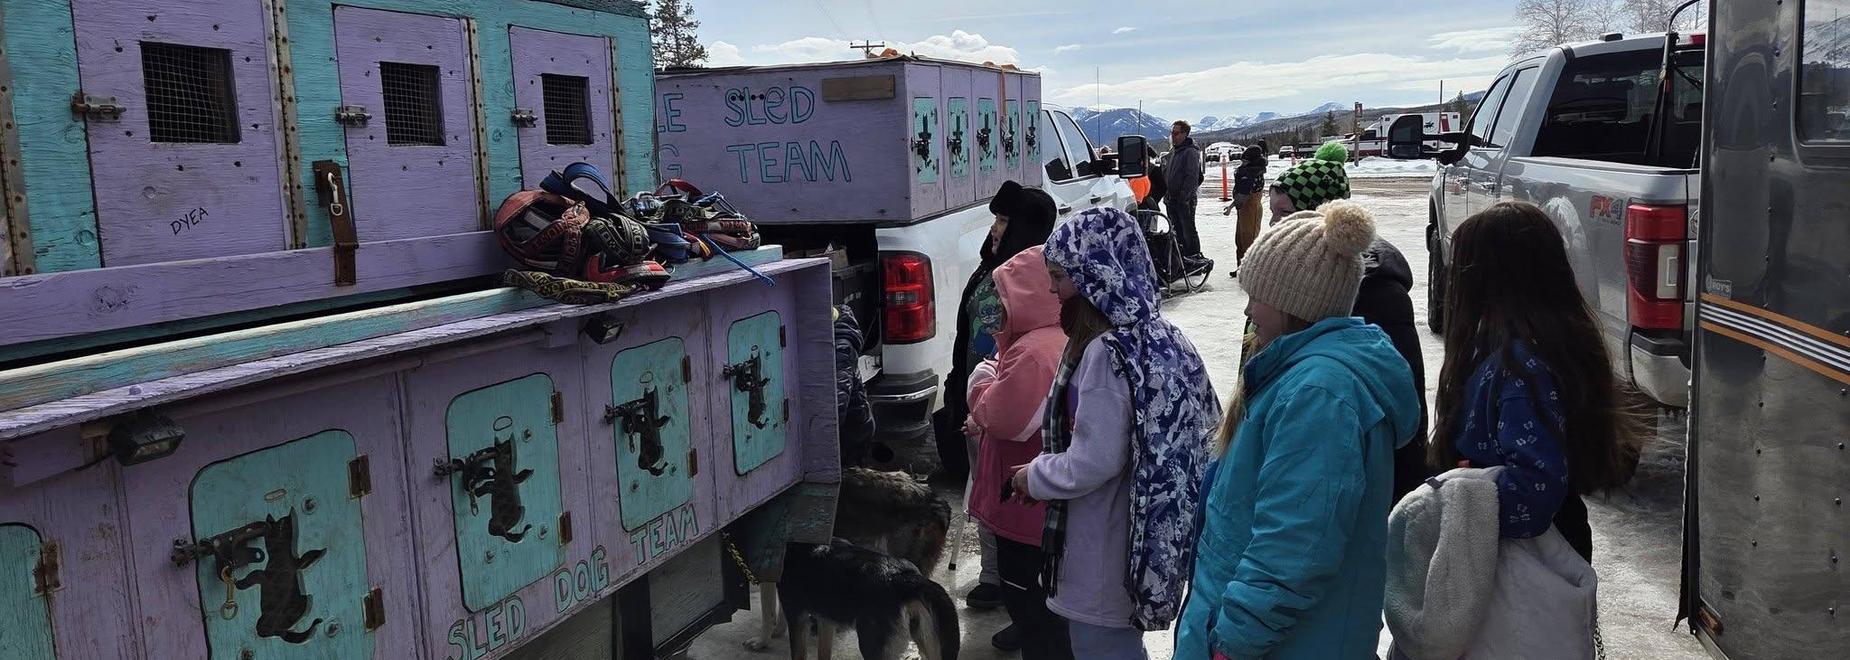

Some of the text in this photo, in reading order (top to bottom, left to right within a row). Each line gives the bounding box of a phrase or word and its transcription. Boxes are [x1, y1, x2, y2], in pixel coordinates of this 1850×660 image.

[658, 93, 687, 133] E
[726, 140, 852, 184] TEAM
[170, 207, 209, 236] DYEA
[1589, 195, 1624, 220] FX4
[447, 502, 700, 660] SLED DOG TEAM
